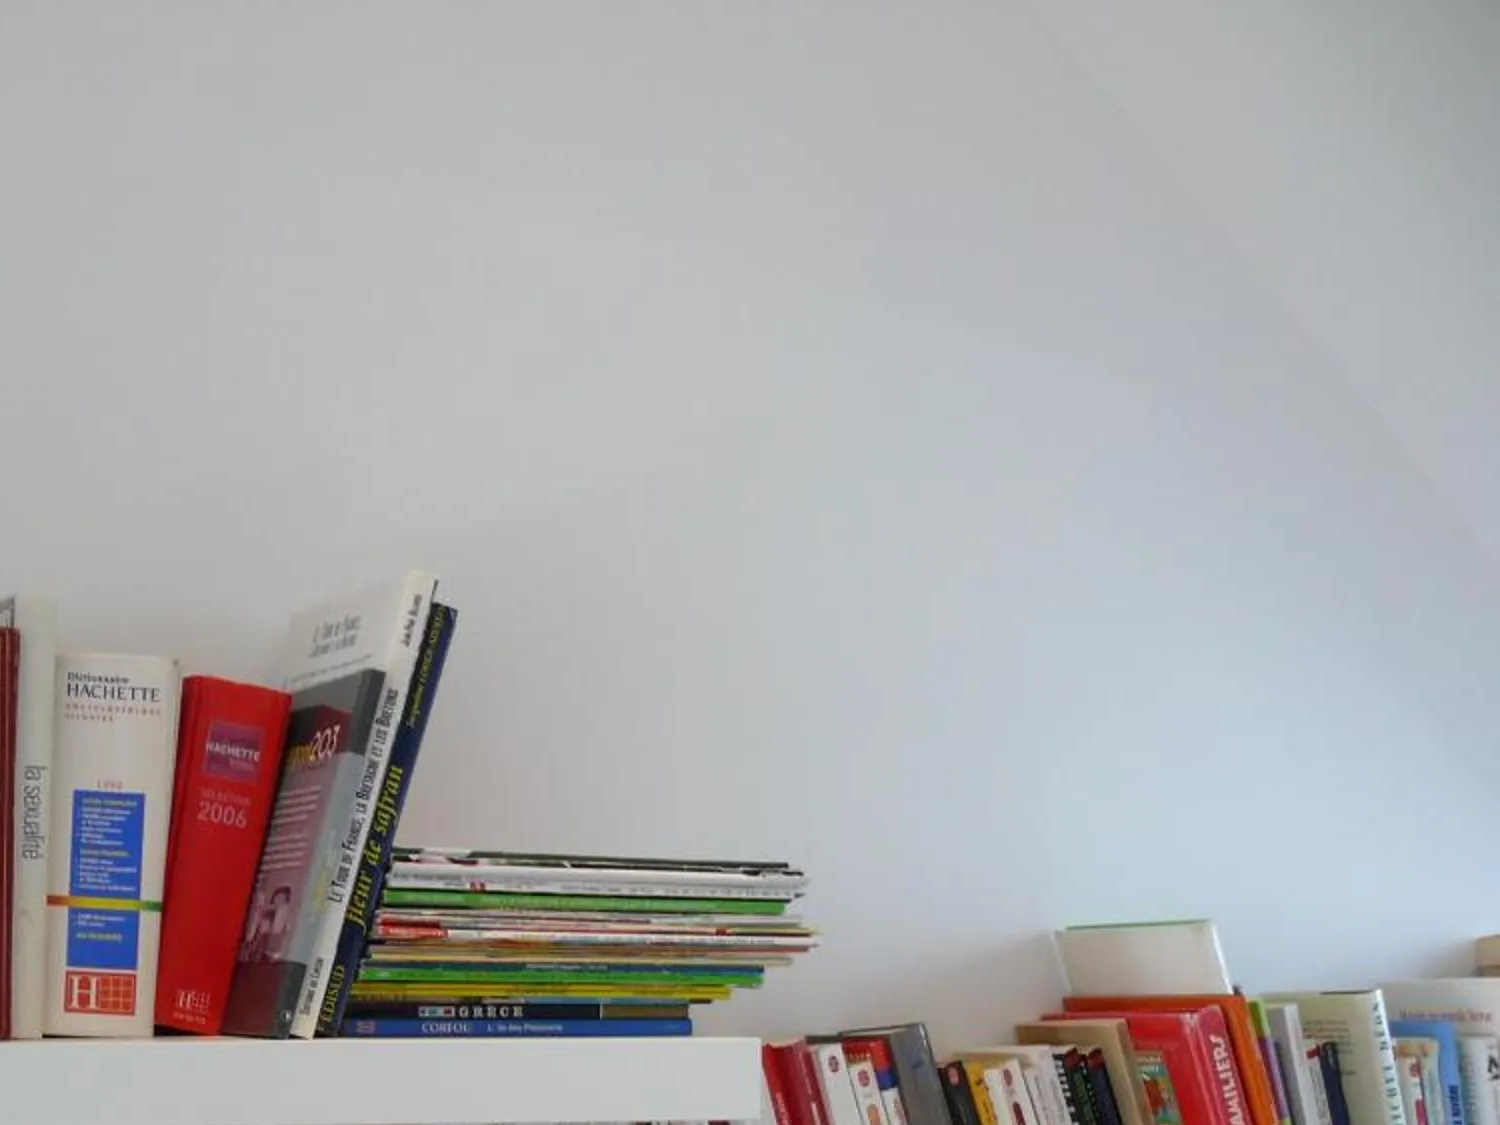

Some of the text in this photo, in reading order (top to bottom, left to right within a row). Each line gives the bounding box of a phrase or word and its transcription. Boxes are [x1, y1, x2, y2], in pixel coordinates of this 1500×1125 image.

[66, 683, 161, 702] HACHETTE
[204, 740, 261, 763] HACHETTE
[20, 764, 47, 860] la sexualité
[196, 800, 250, 828] 2006
[342, 763, 412, 931] fleur de safran
